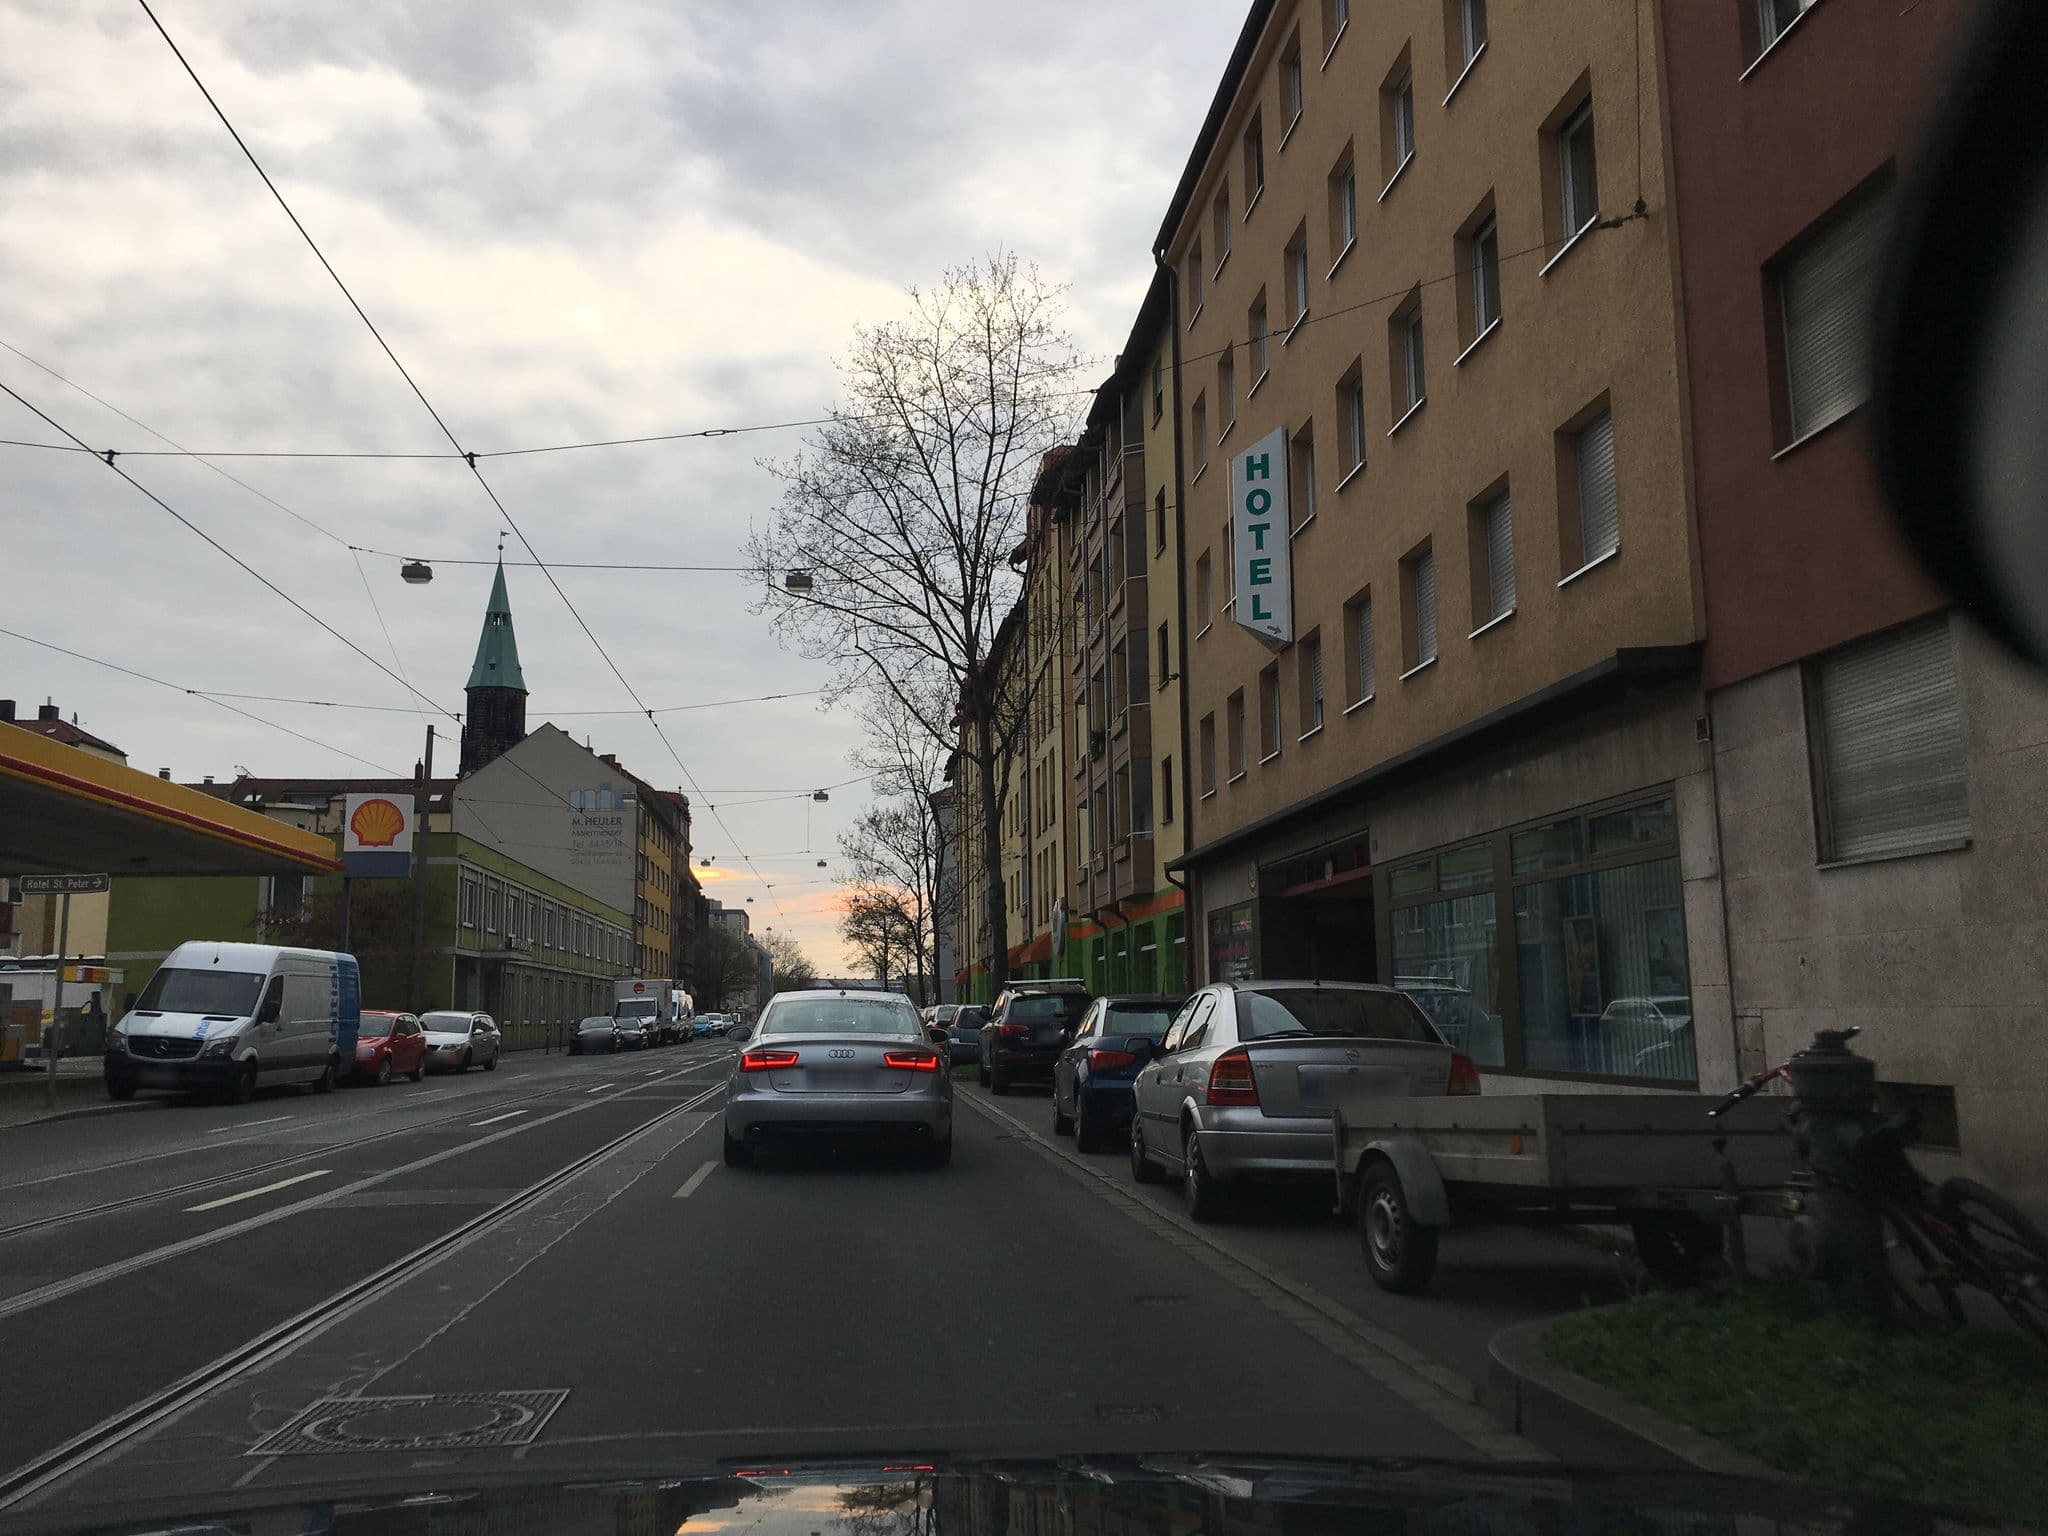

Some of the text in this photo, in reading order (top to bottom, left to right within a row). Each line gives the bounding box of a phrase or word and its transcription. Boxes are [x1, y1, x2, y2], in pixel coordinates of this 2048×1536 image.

[1245, 452, 1273, 621] HOTEL
[585, 816, 623, 826] HEULER
[26, 879, 50, 889] Hotel
[67, 878, 89, 889] Peter
